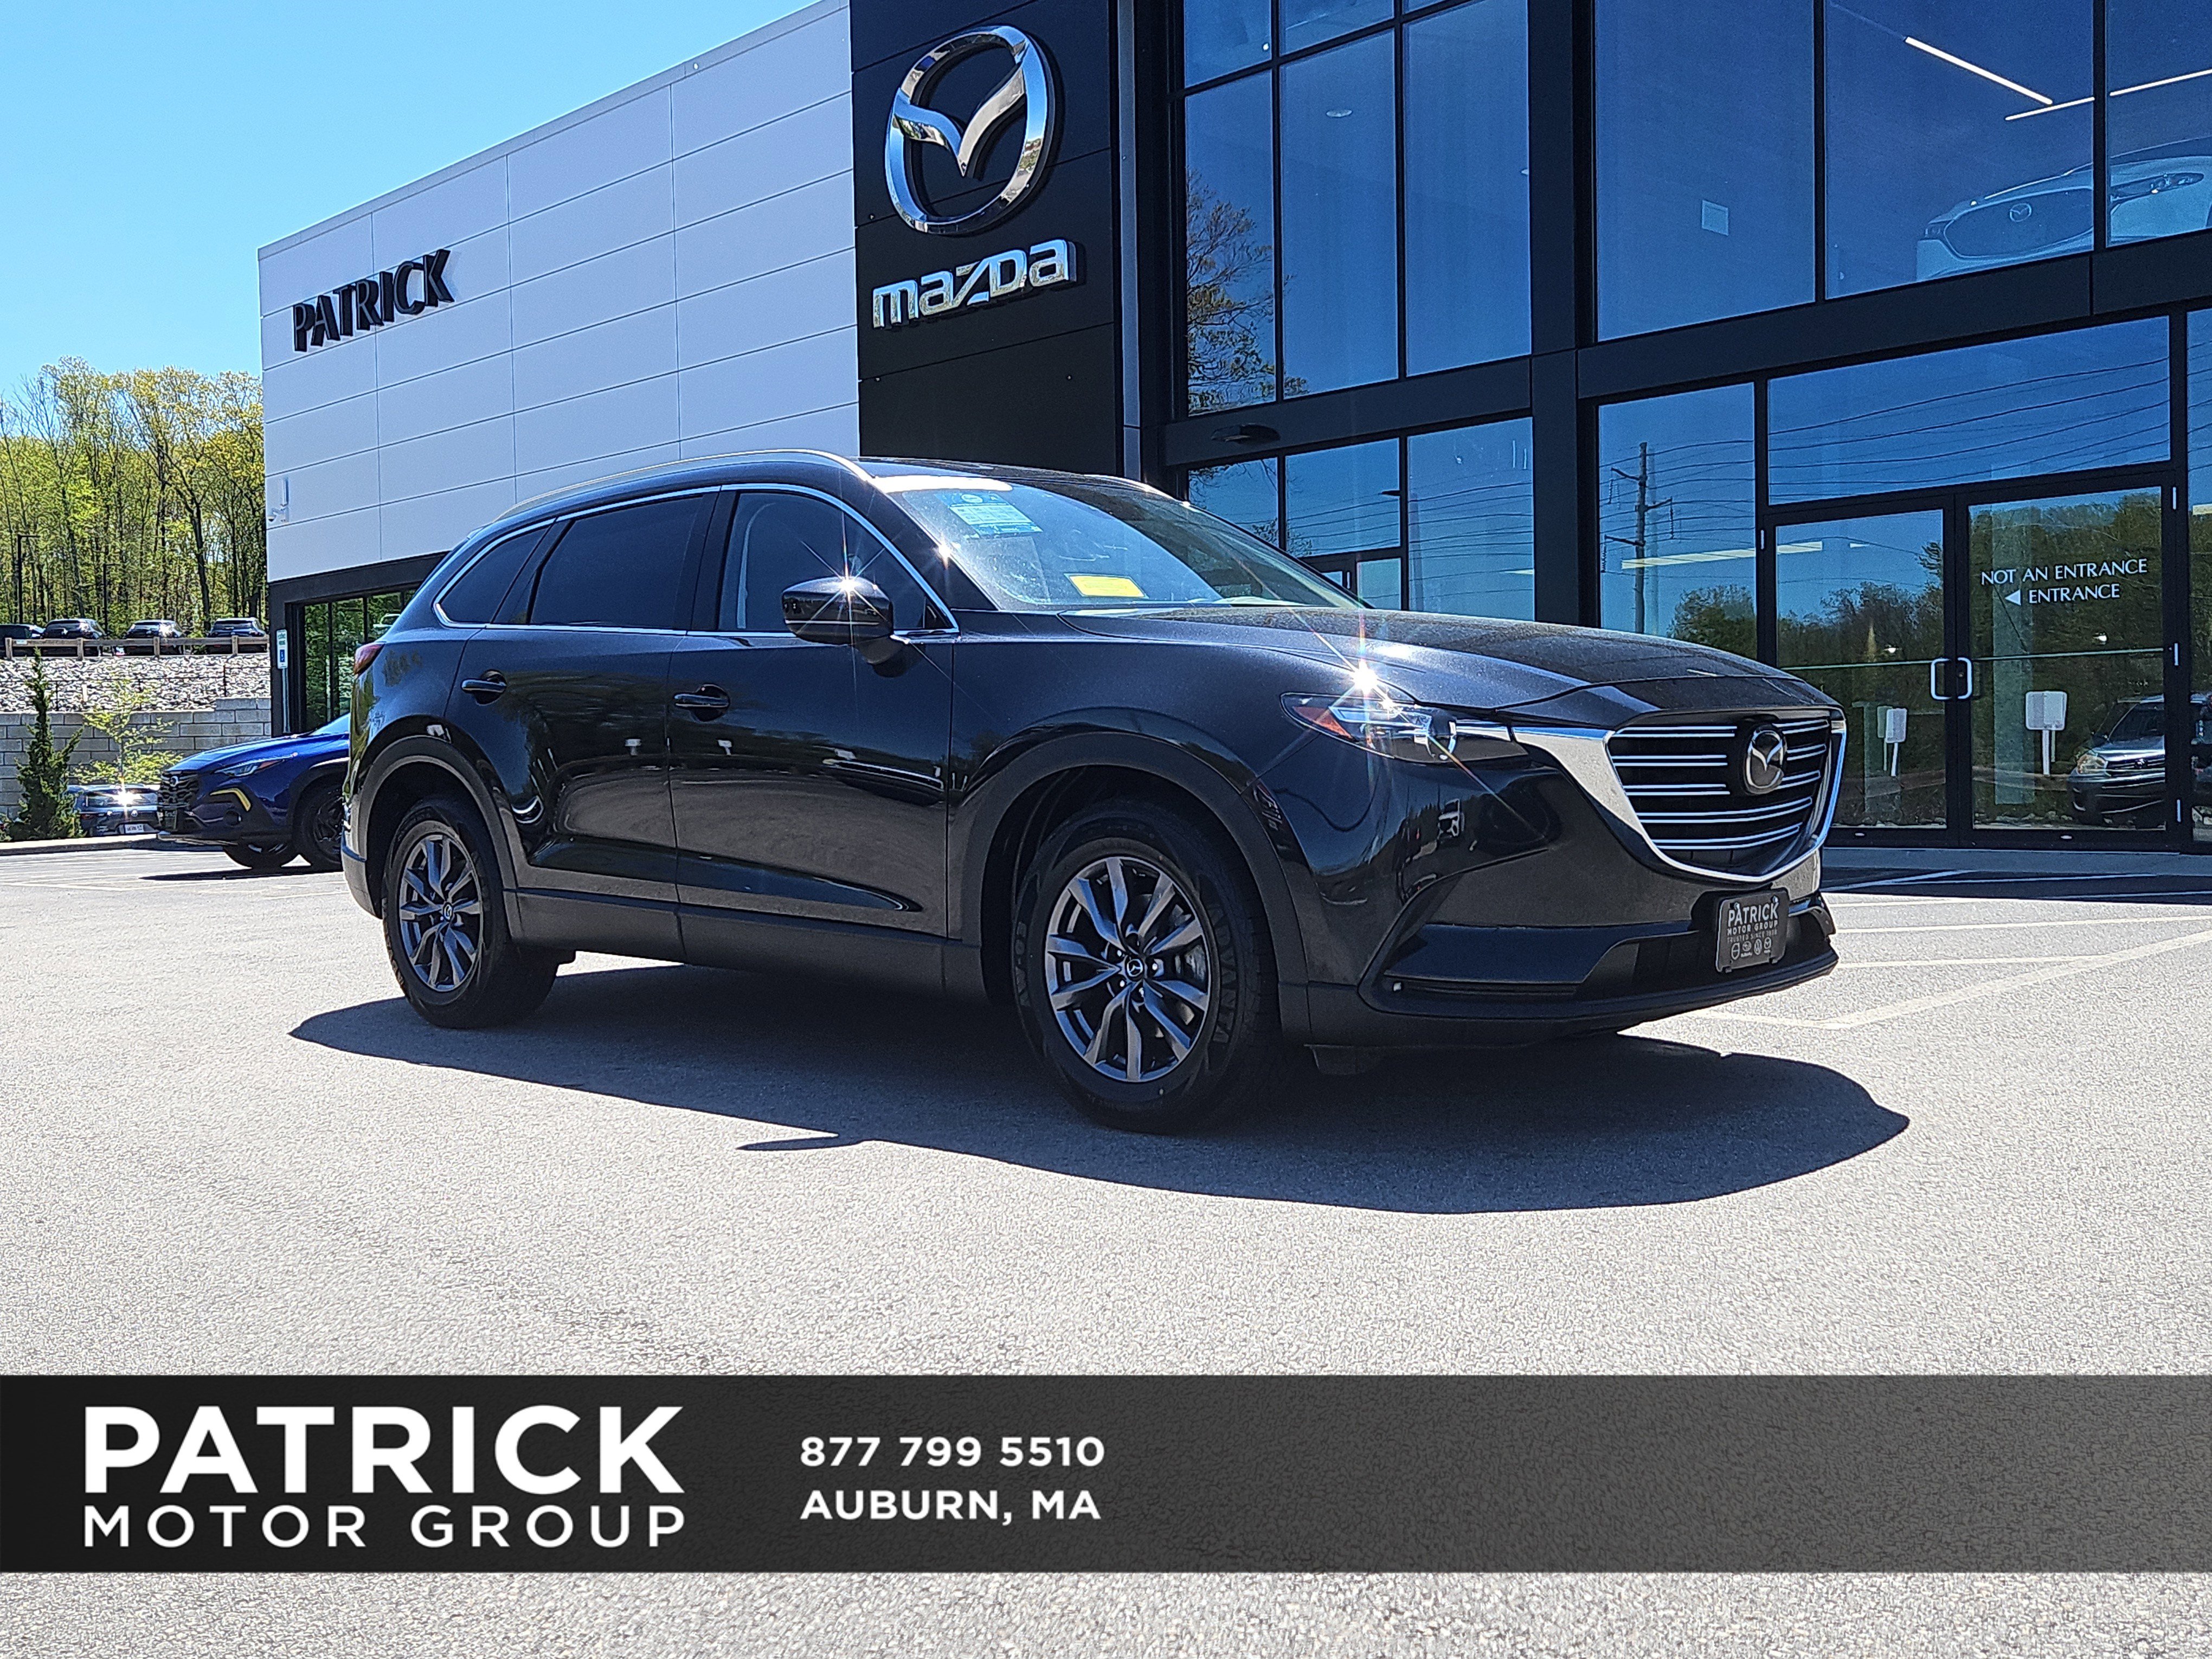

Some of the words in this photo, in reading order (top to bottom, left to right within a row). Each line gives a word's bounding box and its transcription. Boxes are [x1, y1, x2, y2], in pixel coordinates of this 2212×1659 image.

[293, 249, 454, 352] PATRICK
[1981, 569, 2016, 586] NOT
[2022, 567, 2048, 582] AN
[2055, 558, 2147, 580] ENTRANCE
[2029, 584, 2120, 604] ENTRANCE
[1728, 902, 1779, 927] PATRICK
[1727, 924, 1751, 936] MOTOR
[1754, 920, 1778, 931] GROUP
